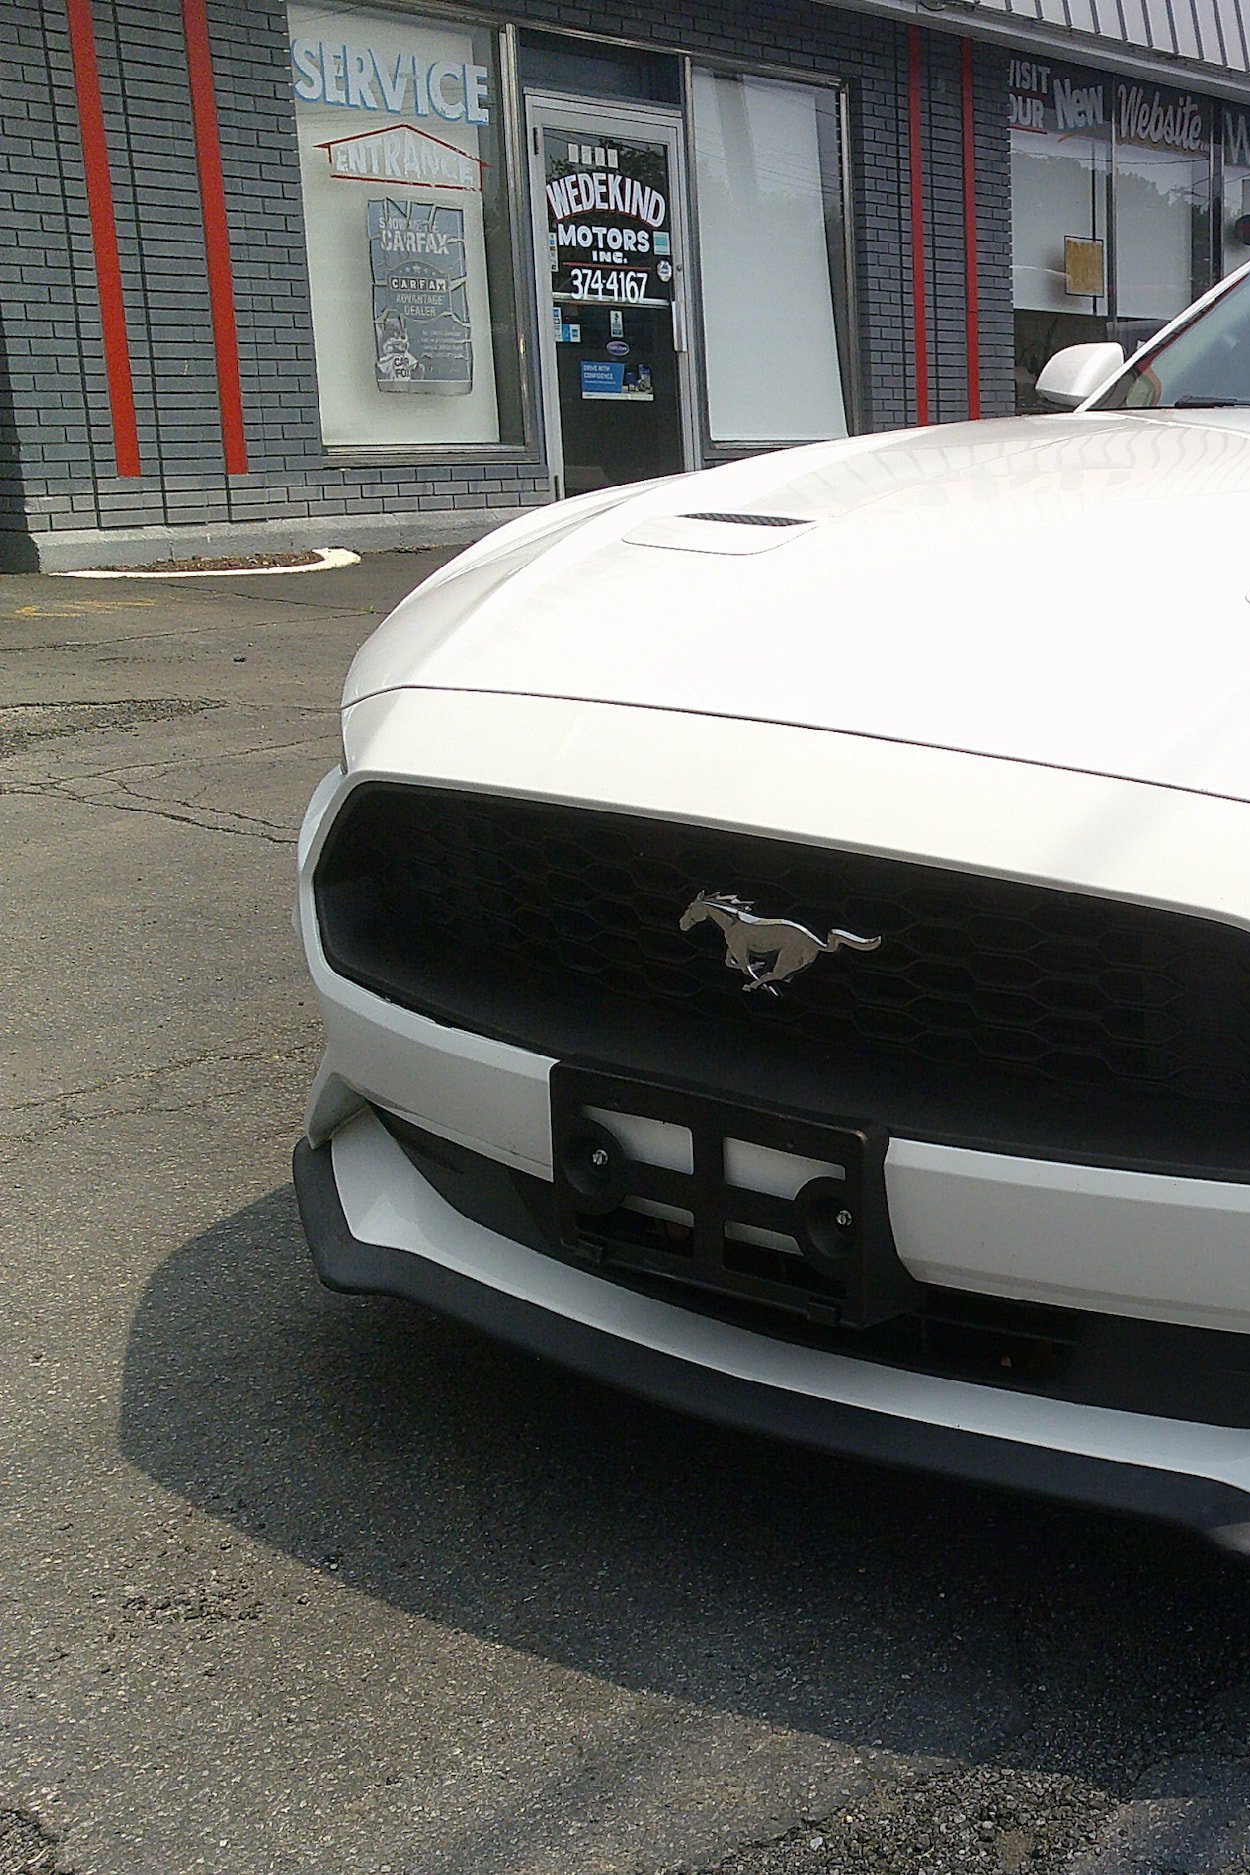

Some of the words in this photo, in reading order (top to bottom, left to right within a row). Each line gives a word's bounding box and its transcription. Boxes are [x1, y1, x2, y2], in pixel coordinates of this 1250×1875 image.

[291, 39, 489, 127] SERVICE
[336, 131, 474, 184] ENTRANCE
[545, 172, 666, 228] WEDEKIND
[381, 229, 450, 255] CARFAX
[558, 224, 650, 252] MOTORS
[592, 251, 628, 264] INC.
[390, 277, 447, 291] CARFAX
[571, 268, 648, 303] 374-4167
[396, 293, 446, 305] ADVANTAGE
[404, 305, 436, 317] DEALER
